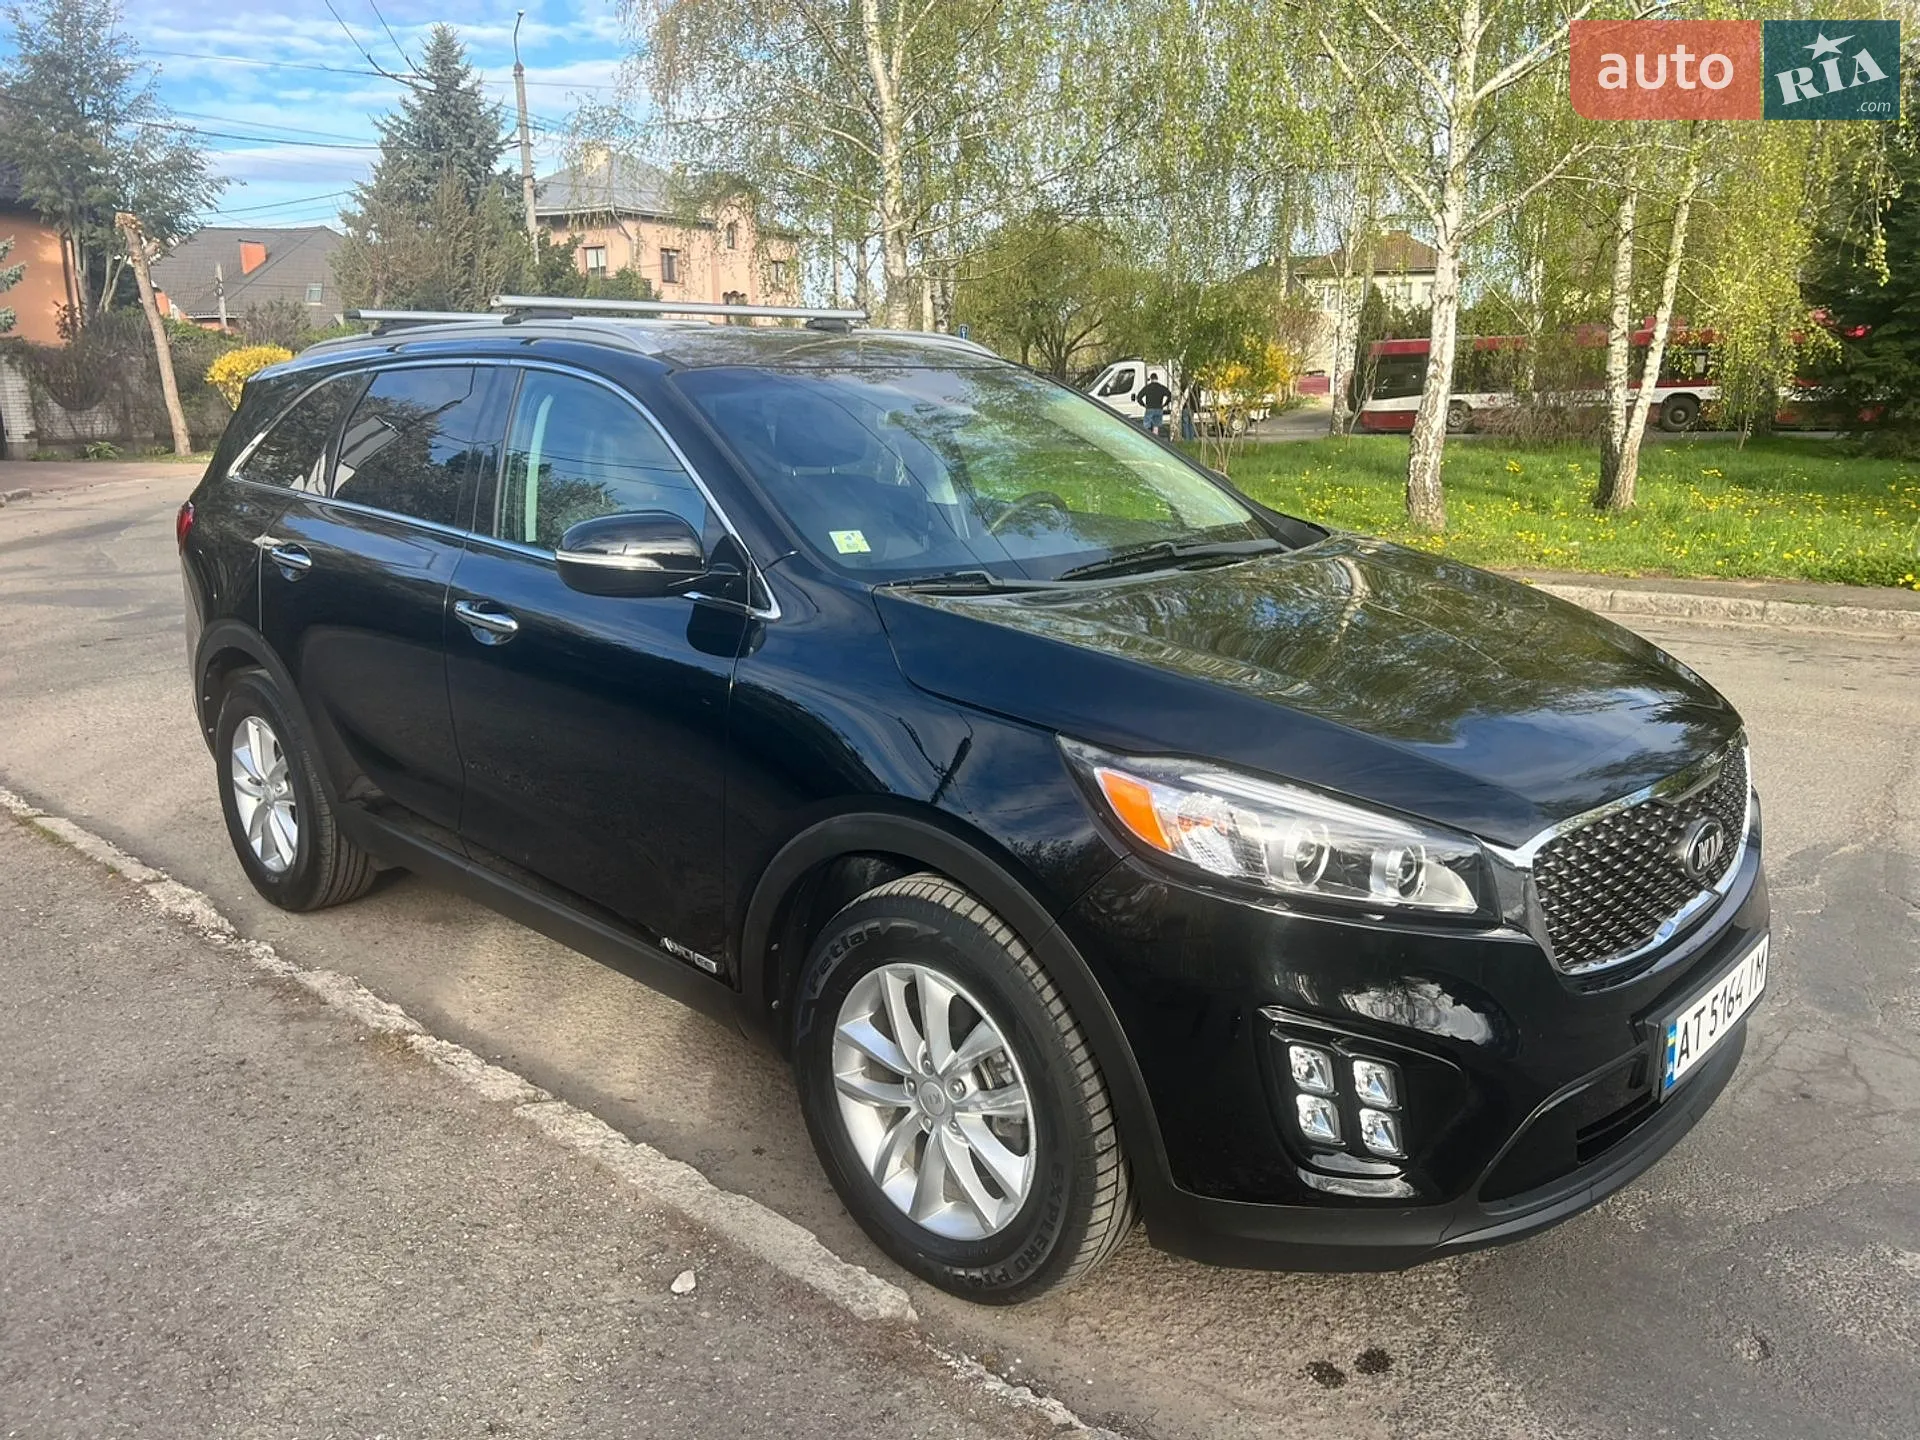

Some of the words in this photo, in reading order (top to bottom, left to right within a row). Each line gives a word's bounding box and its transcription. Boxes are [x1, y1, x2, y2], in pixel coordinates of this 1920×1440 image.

[1697, 830, 1723, 870] KIA
[1677, 1005, 1706, 1068] AT
[1709, 968, 1744, 1037] 5164
[1748, 943, 1767, 998] IM
